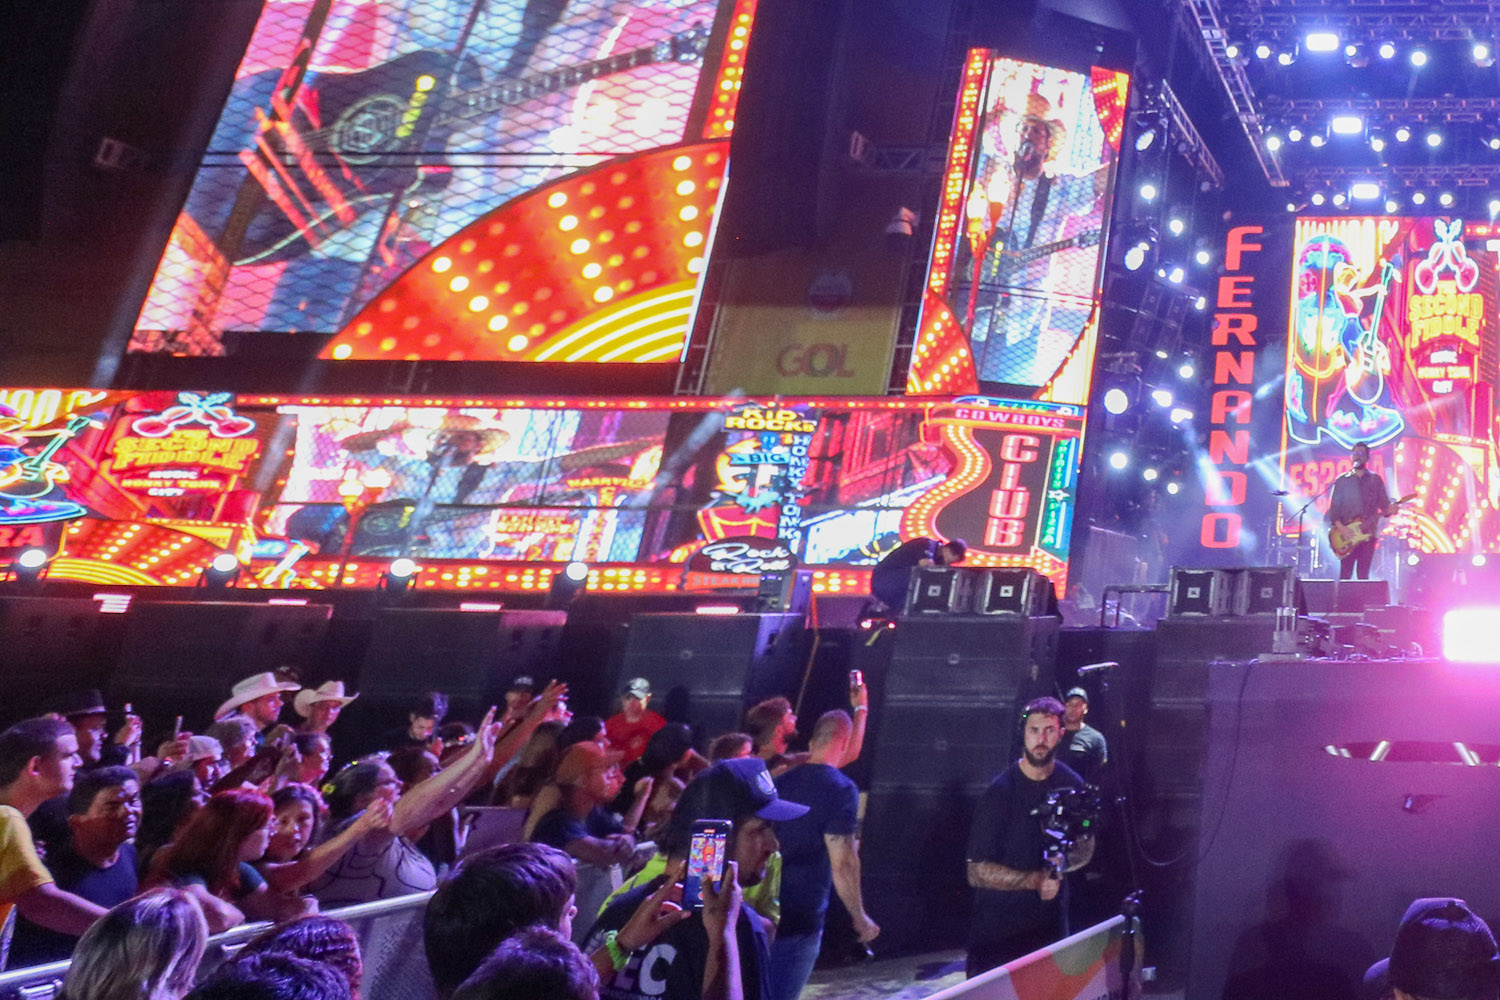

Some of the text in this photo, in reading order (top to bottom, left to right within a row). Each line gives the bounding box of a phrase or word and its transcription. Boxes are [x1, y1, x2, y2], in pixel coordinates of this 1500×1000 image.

[1409, 293, 1484, 322] SECOND
[1410, 315, 1480, 349] FIDDLE
[776, 343, 855, 378] GOL
[1201, 226, 1263, 548] FERNANDO
[742, 408, 798, 420] KID
[955, 408, 1065, 428] COWBOYS
[113, 437, 259, 453] SECOND
[112, 451, 245, 469] FIDDLE
[750, 453, 786, 464] BIG
[984, 434, 1040, 546] CLUB
[702, 542, 790, 560] Rock
